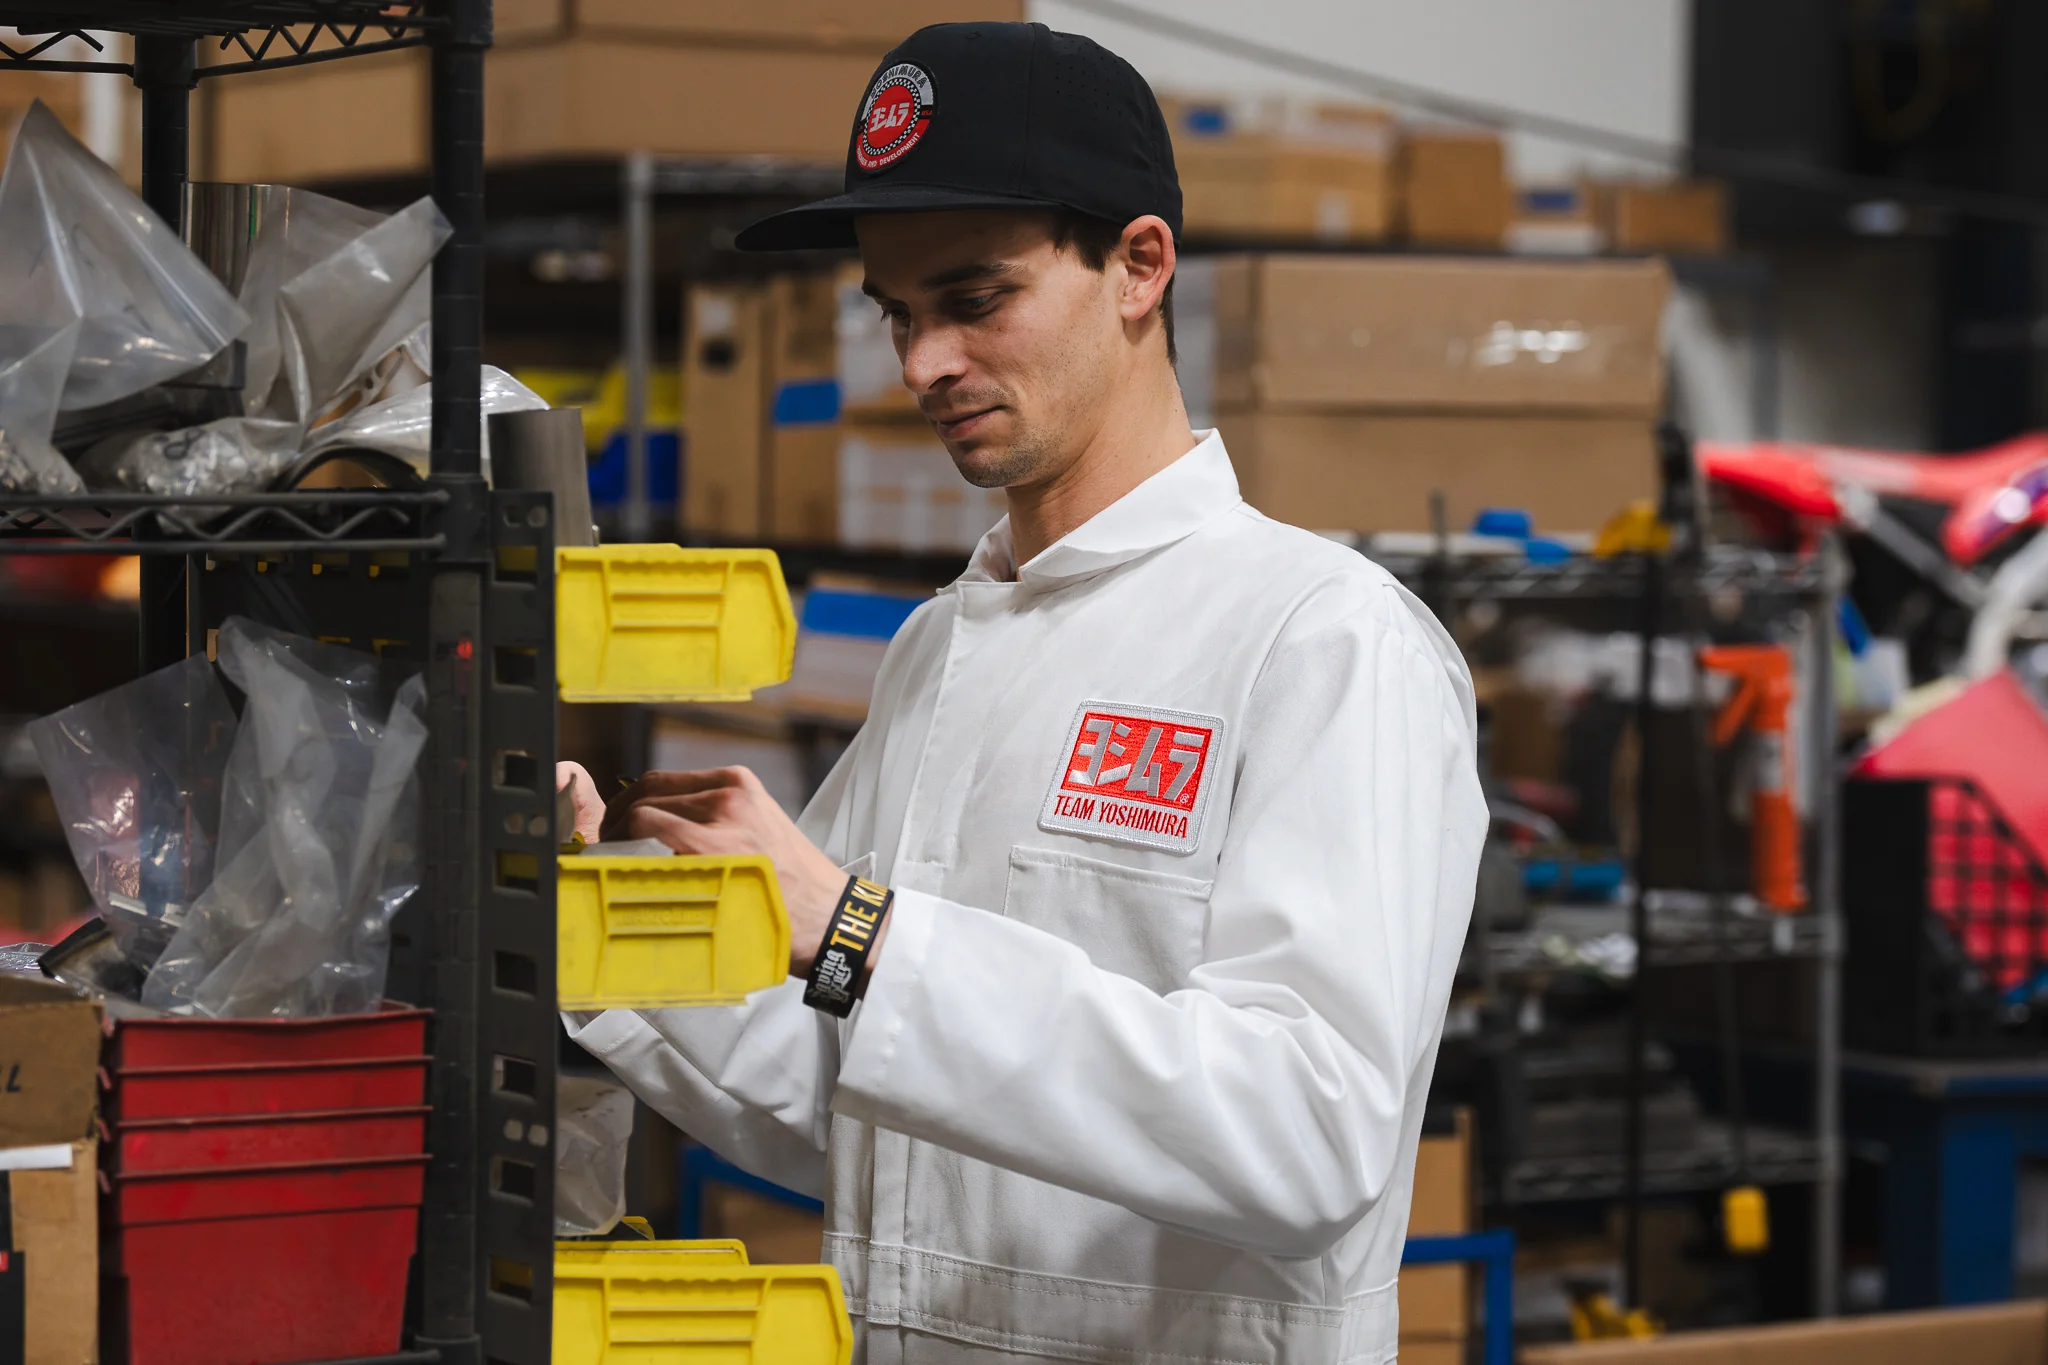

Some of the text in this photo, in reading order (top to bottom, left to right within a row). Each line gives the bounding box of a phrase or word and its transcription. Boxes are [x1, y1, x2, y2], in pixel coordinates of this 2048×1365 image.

[879, 132, 921, 166] DEVELOPMENT
[1053, 795, 1189, 839] TEAM YOSHIMURA
[830, 900, 879, 952] THE
